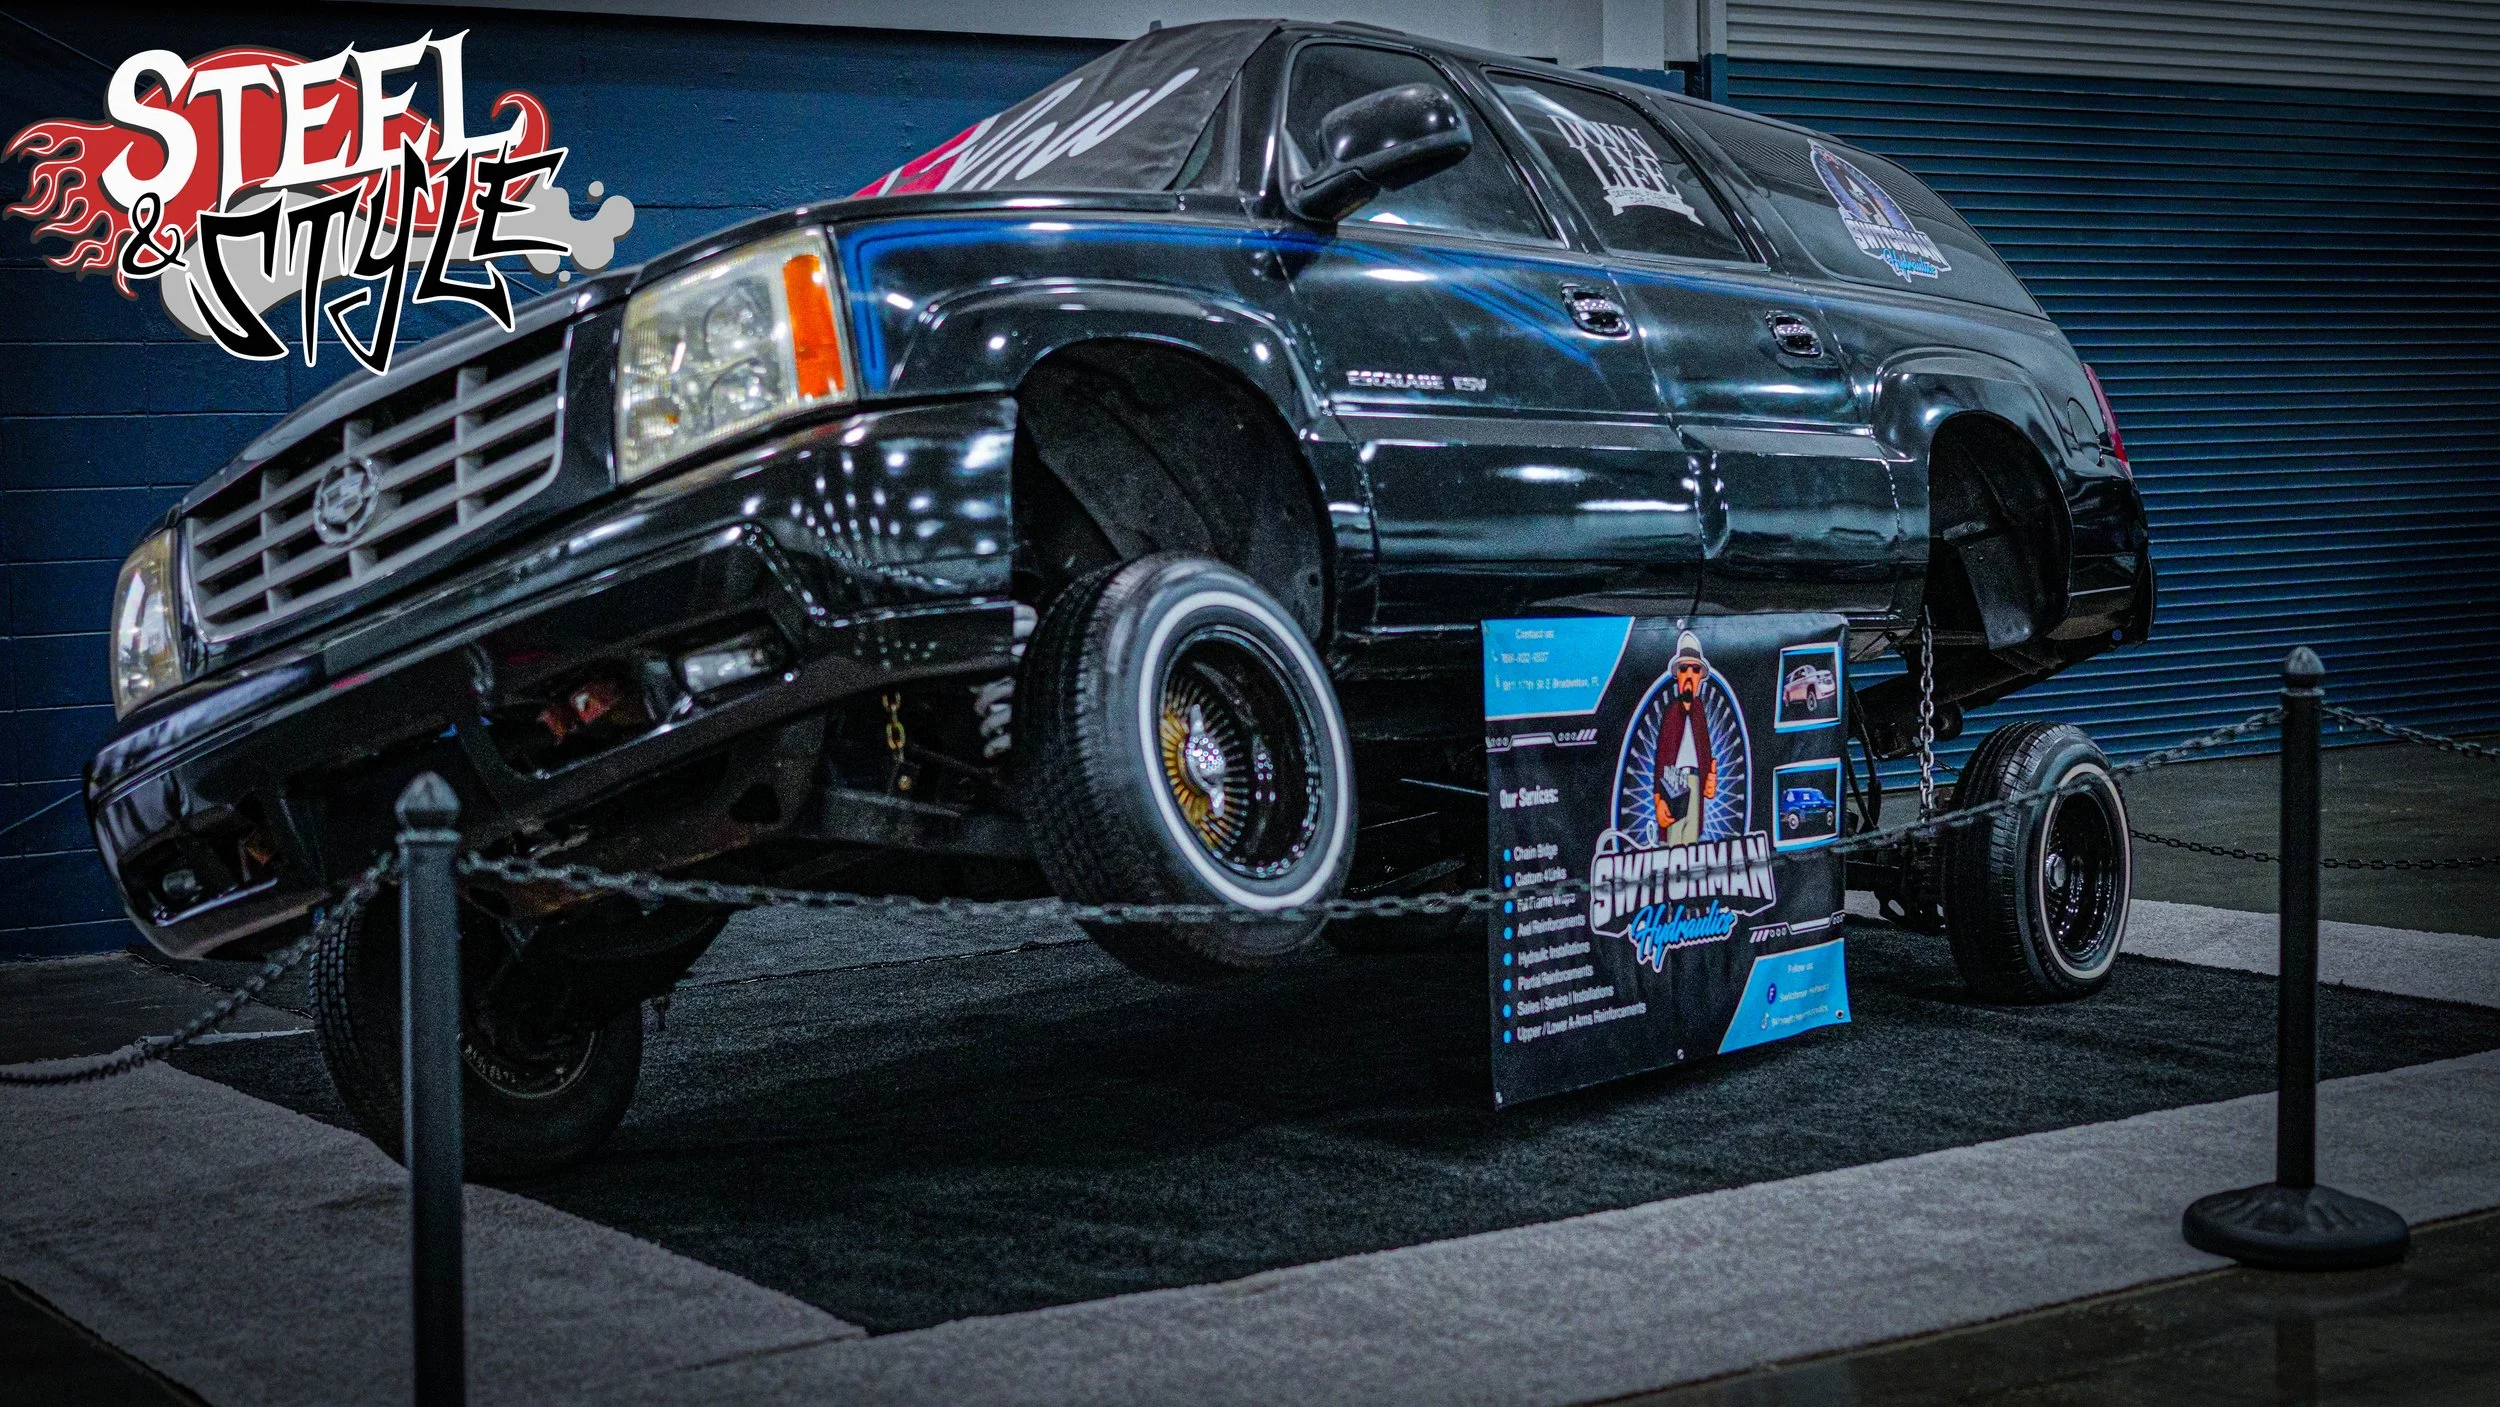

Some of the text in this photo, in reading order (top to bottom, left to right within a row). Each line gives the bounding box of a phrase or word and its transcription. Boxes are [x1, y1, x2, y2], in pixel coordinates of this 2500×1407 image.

[1546, 114, 1659, 162] DOWN
[1843, 218, 1942, 264] SWITCHMAN
[1500, 785, 1559, 809] Our Services:
[1514, 845, 1537, 861] Chain
[1594, 836, 1773, 928] SWITCHMAN
[1630, 899, 1736, 970] Hydraulics
[1517, 1026, 1542, 1043] Upper
